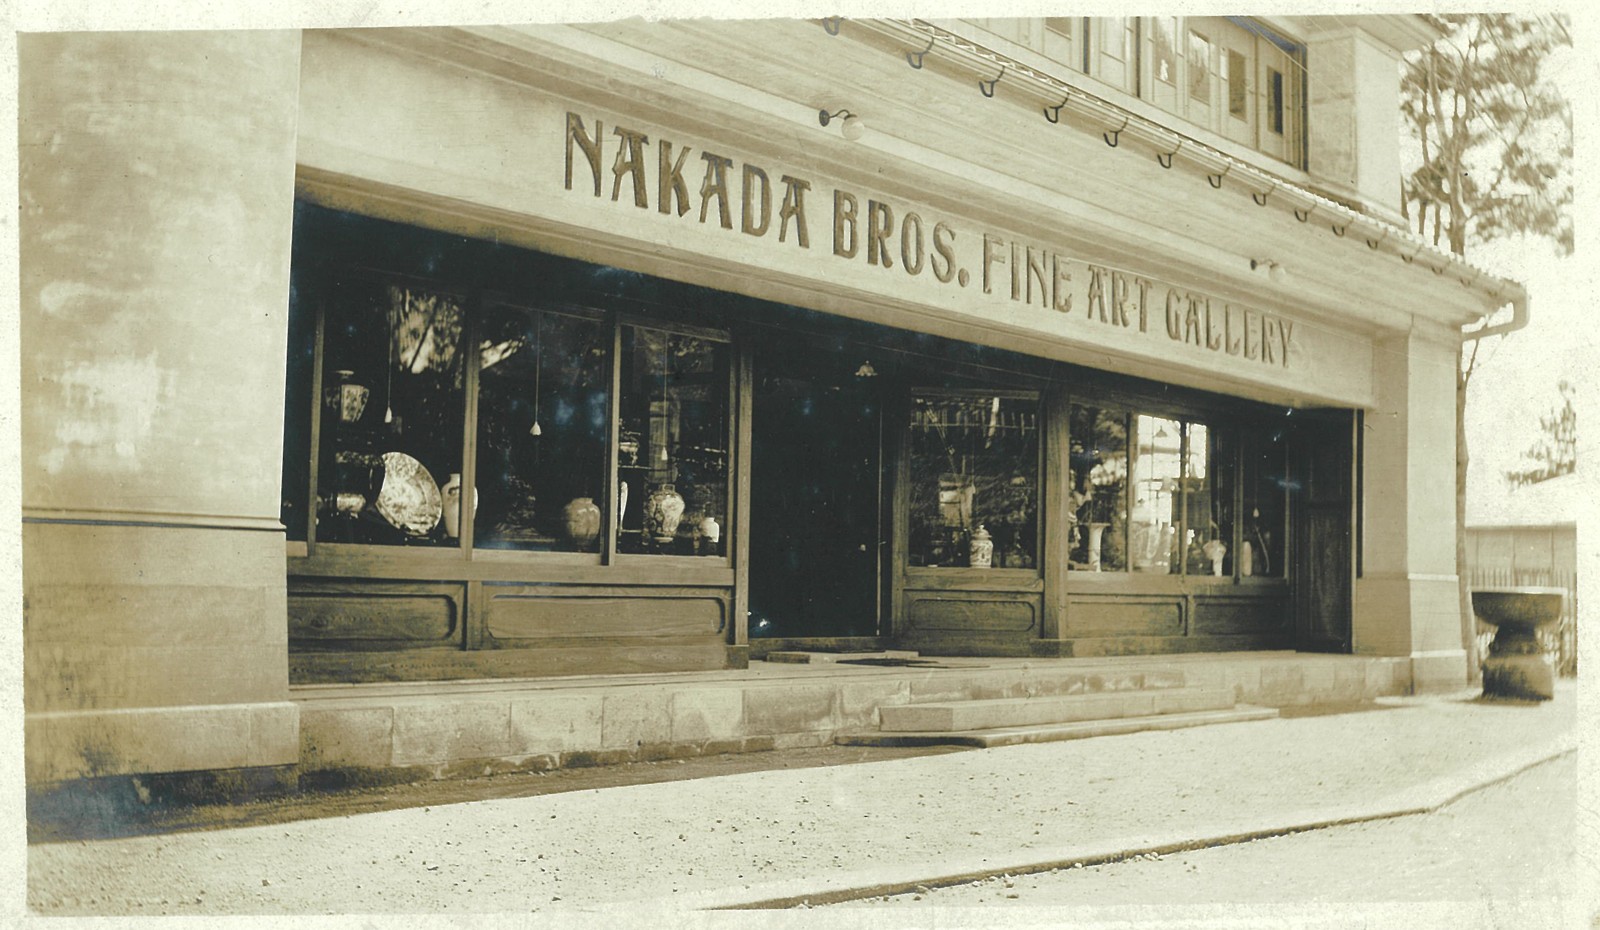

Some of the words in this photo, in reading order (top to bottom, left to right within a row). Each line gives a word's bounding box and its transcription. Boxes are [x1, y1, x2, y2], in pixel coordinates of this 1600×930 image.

[564, 111, 811, 248] NAKADA
[832, 189, 970, 288] BROS.
[982, 233, 1072, 313] FINE
[1087, 264, 1153, 333] ART
[1165, 287, 1294, 368] GALLERY
